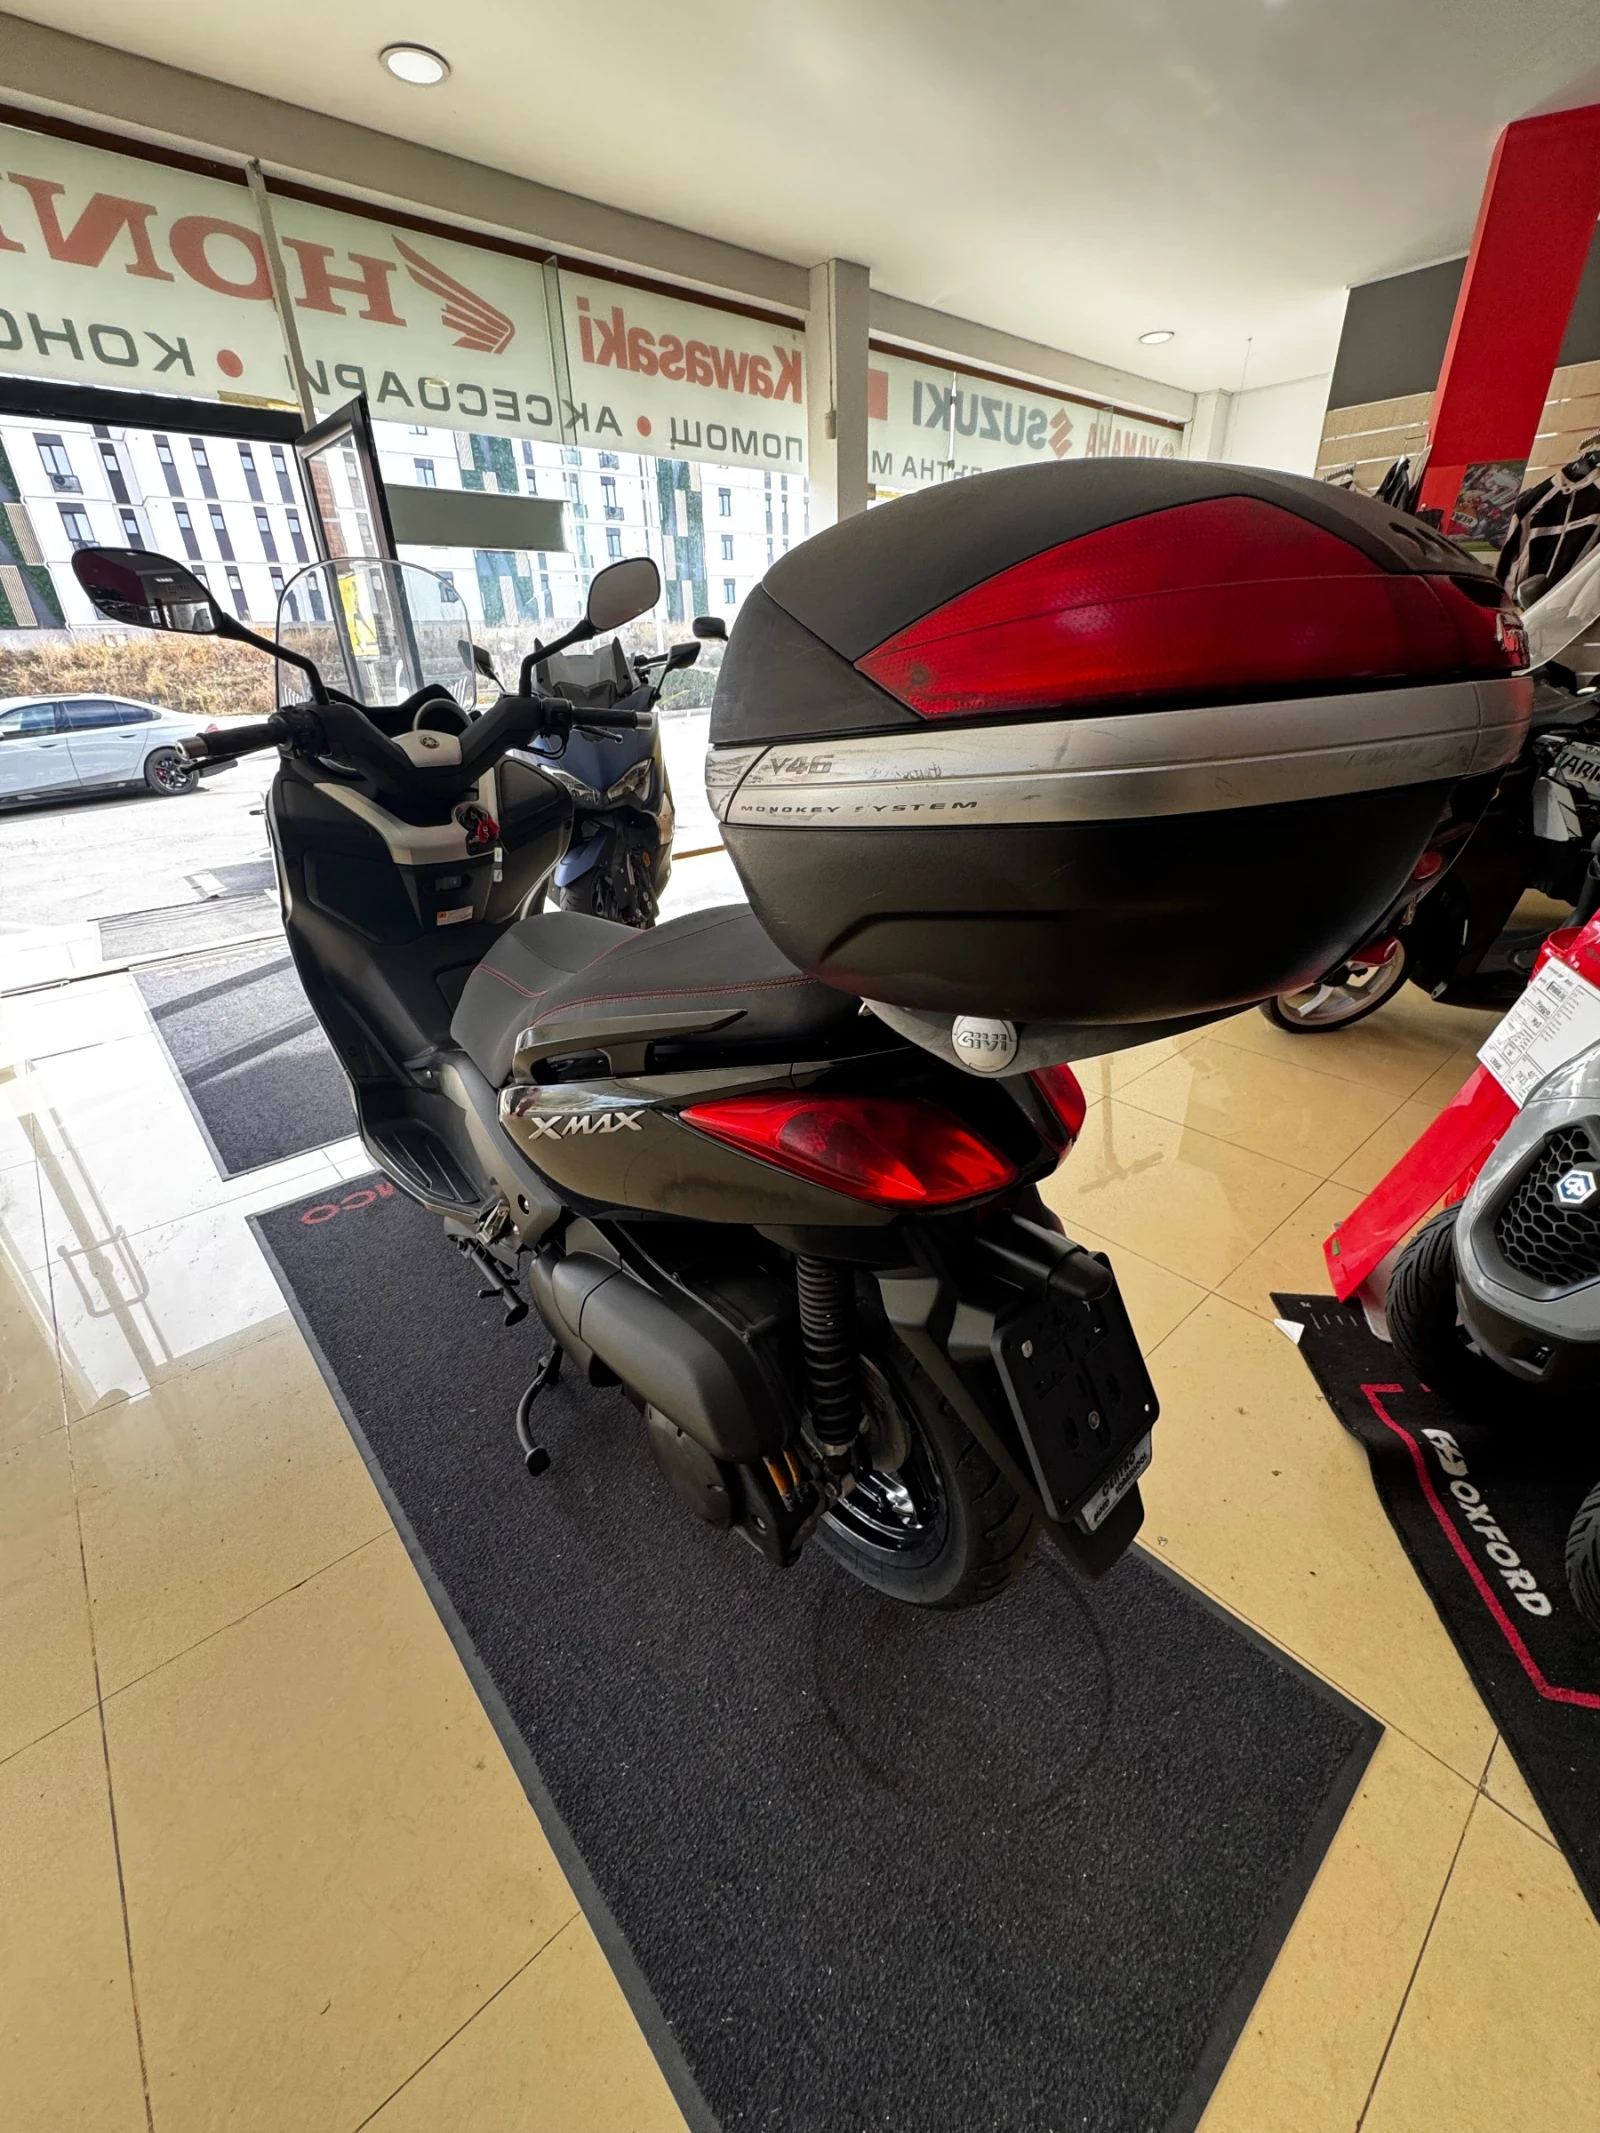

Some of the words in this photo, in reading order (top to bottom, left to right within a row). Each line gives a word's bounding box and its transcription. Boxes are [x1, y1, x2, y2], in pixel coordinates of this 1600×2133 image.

[769, 754, 835, 776] V46
[740, 805, 841, 814] MONOKEY
[1101, 1452, 1136, 1497] CENTRO
[1450, 1480, 1553, 1617] OXFORD
